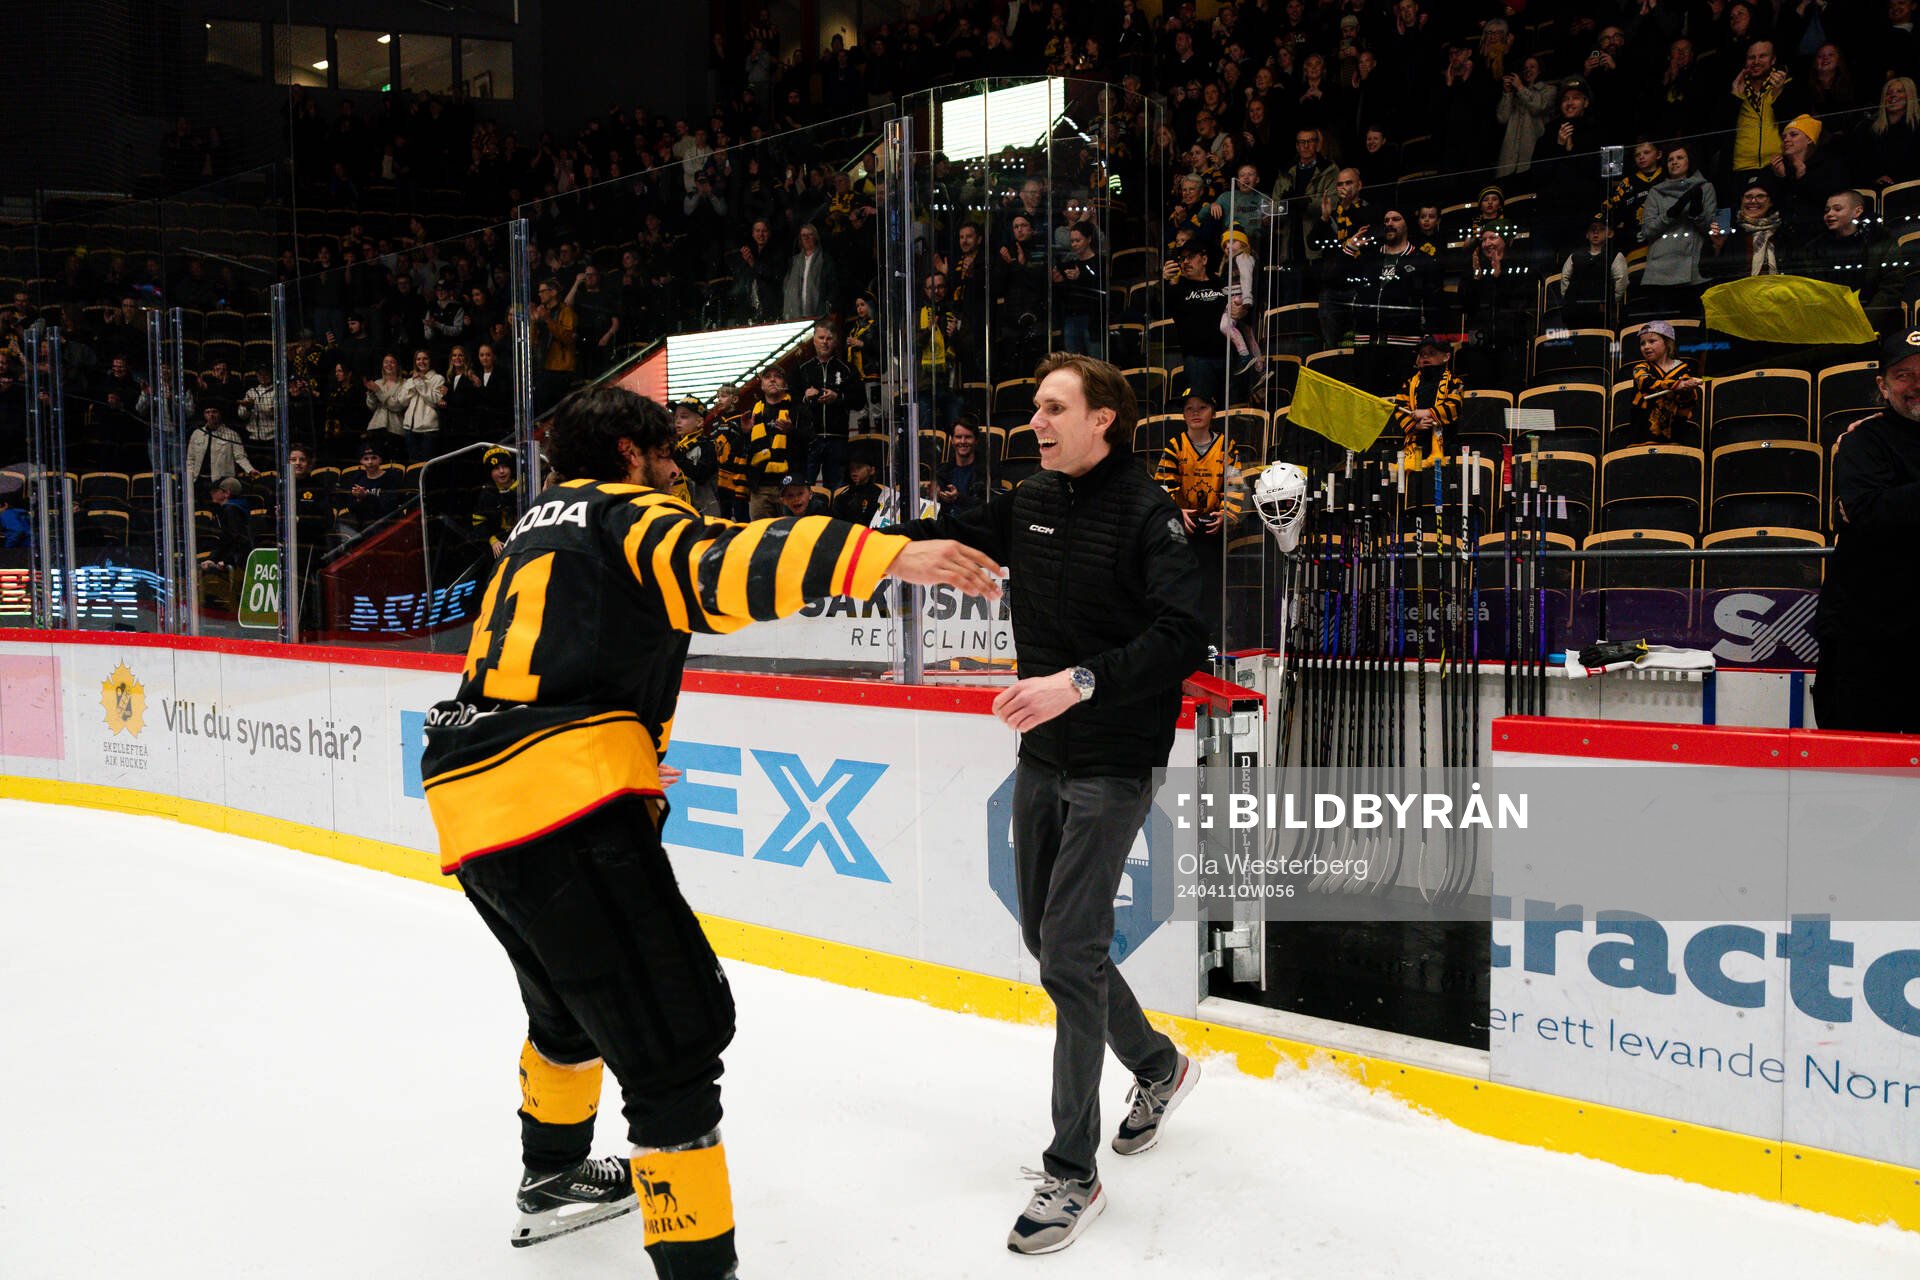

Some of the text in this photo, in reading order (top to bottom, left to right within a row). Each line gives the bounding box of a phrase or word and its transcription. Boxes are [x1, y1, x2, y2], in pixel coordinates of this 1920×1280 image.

[1029, 524, 1055, 535] CCM
[1415, 516, 1423, 558] CCM
[162, 699, 362, 762] Vill du synas här?
[119, 756, 148, 770] HOCKEY
[1537, 1016, 1594, 1048] ett
[1610, 1019, 1785, 1083] levande
